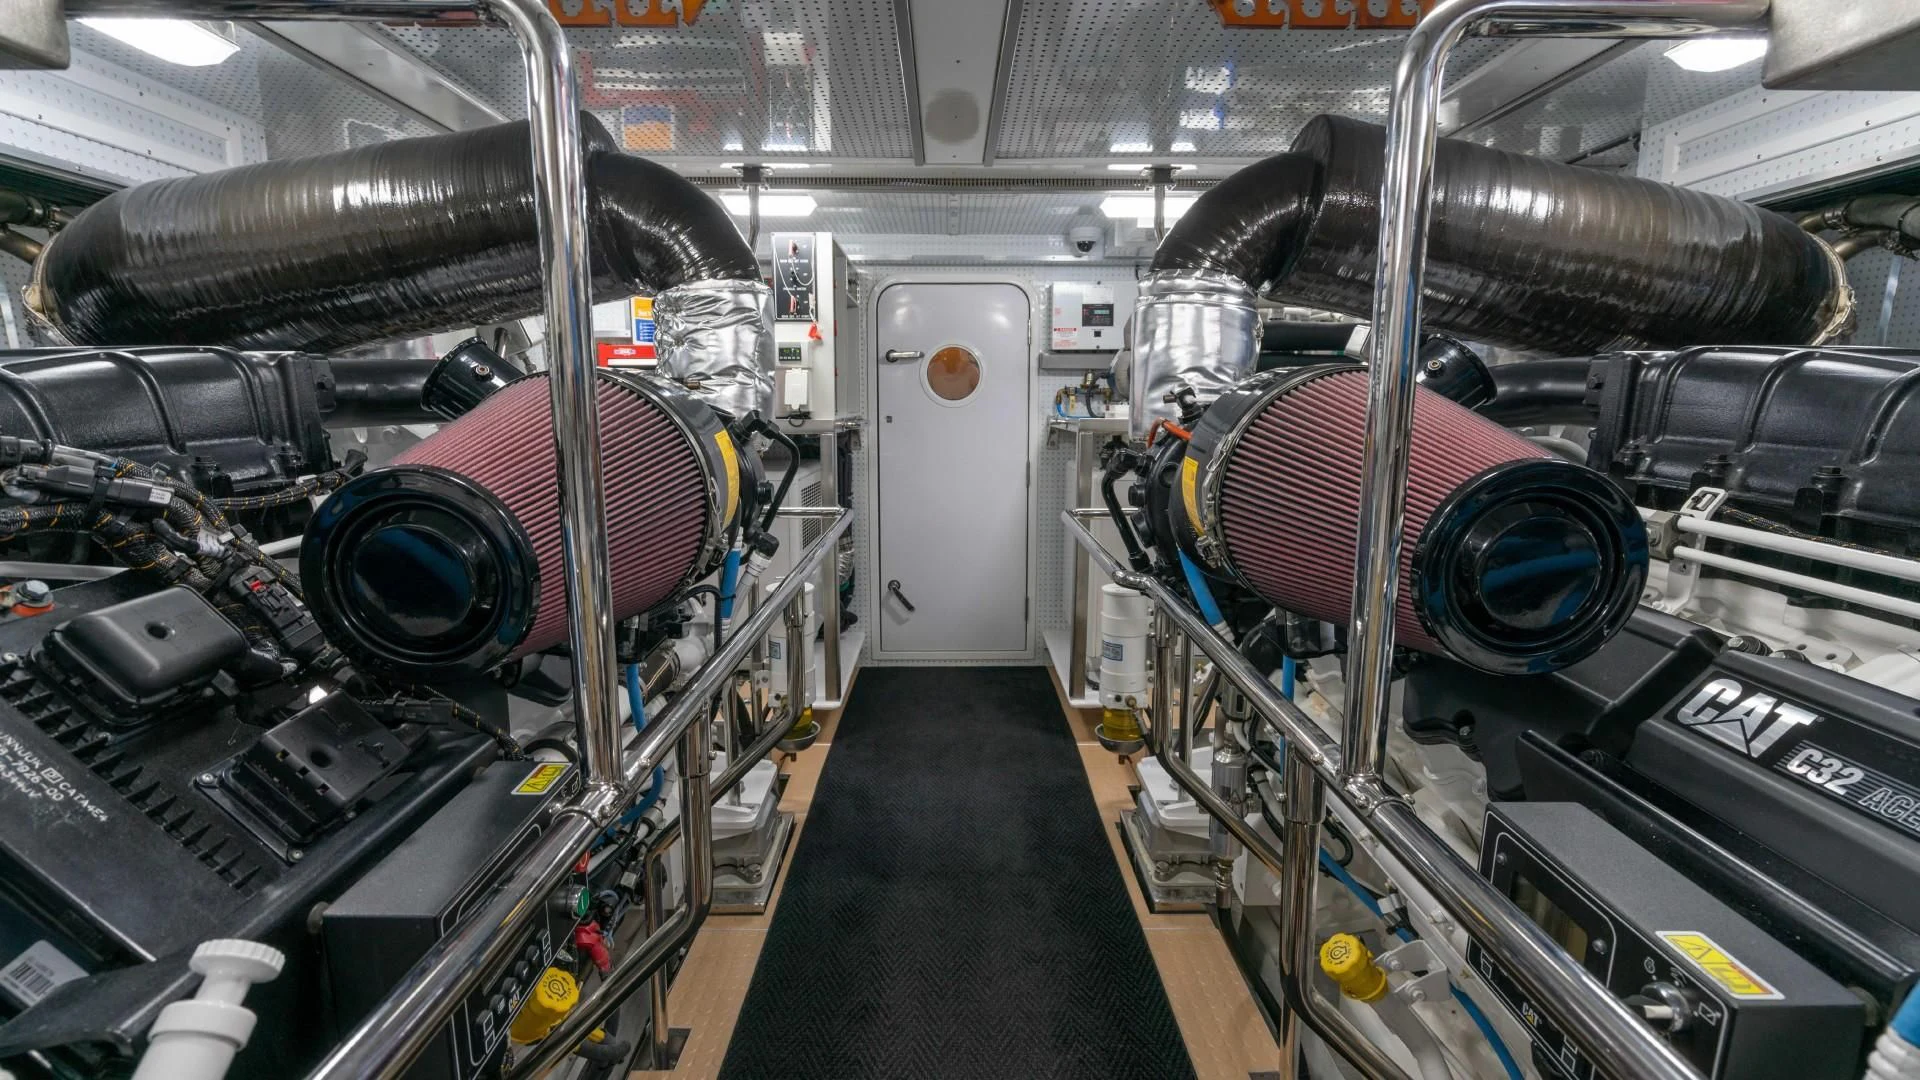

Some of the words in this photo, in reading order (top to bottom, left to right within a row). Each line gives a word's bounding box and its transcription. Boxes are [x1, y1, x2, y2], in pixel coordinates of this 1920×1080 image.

[1677, 679, 1818, 758] CAT
[1786, 748, 1865, 795] C32
[1857, 787, 1920, 832] ACE
[1522, 1002, 1539, 1028] CAT
